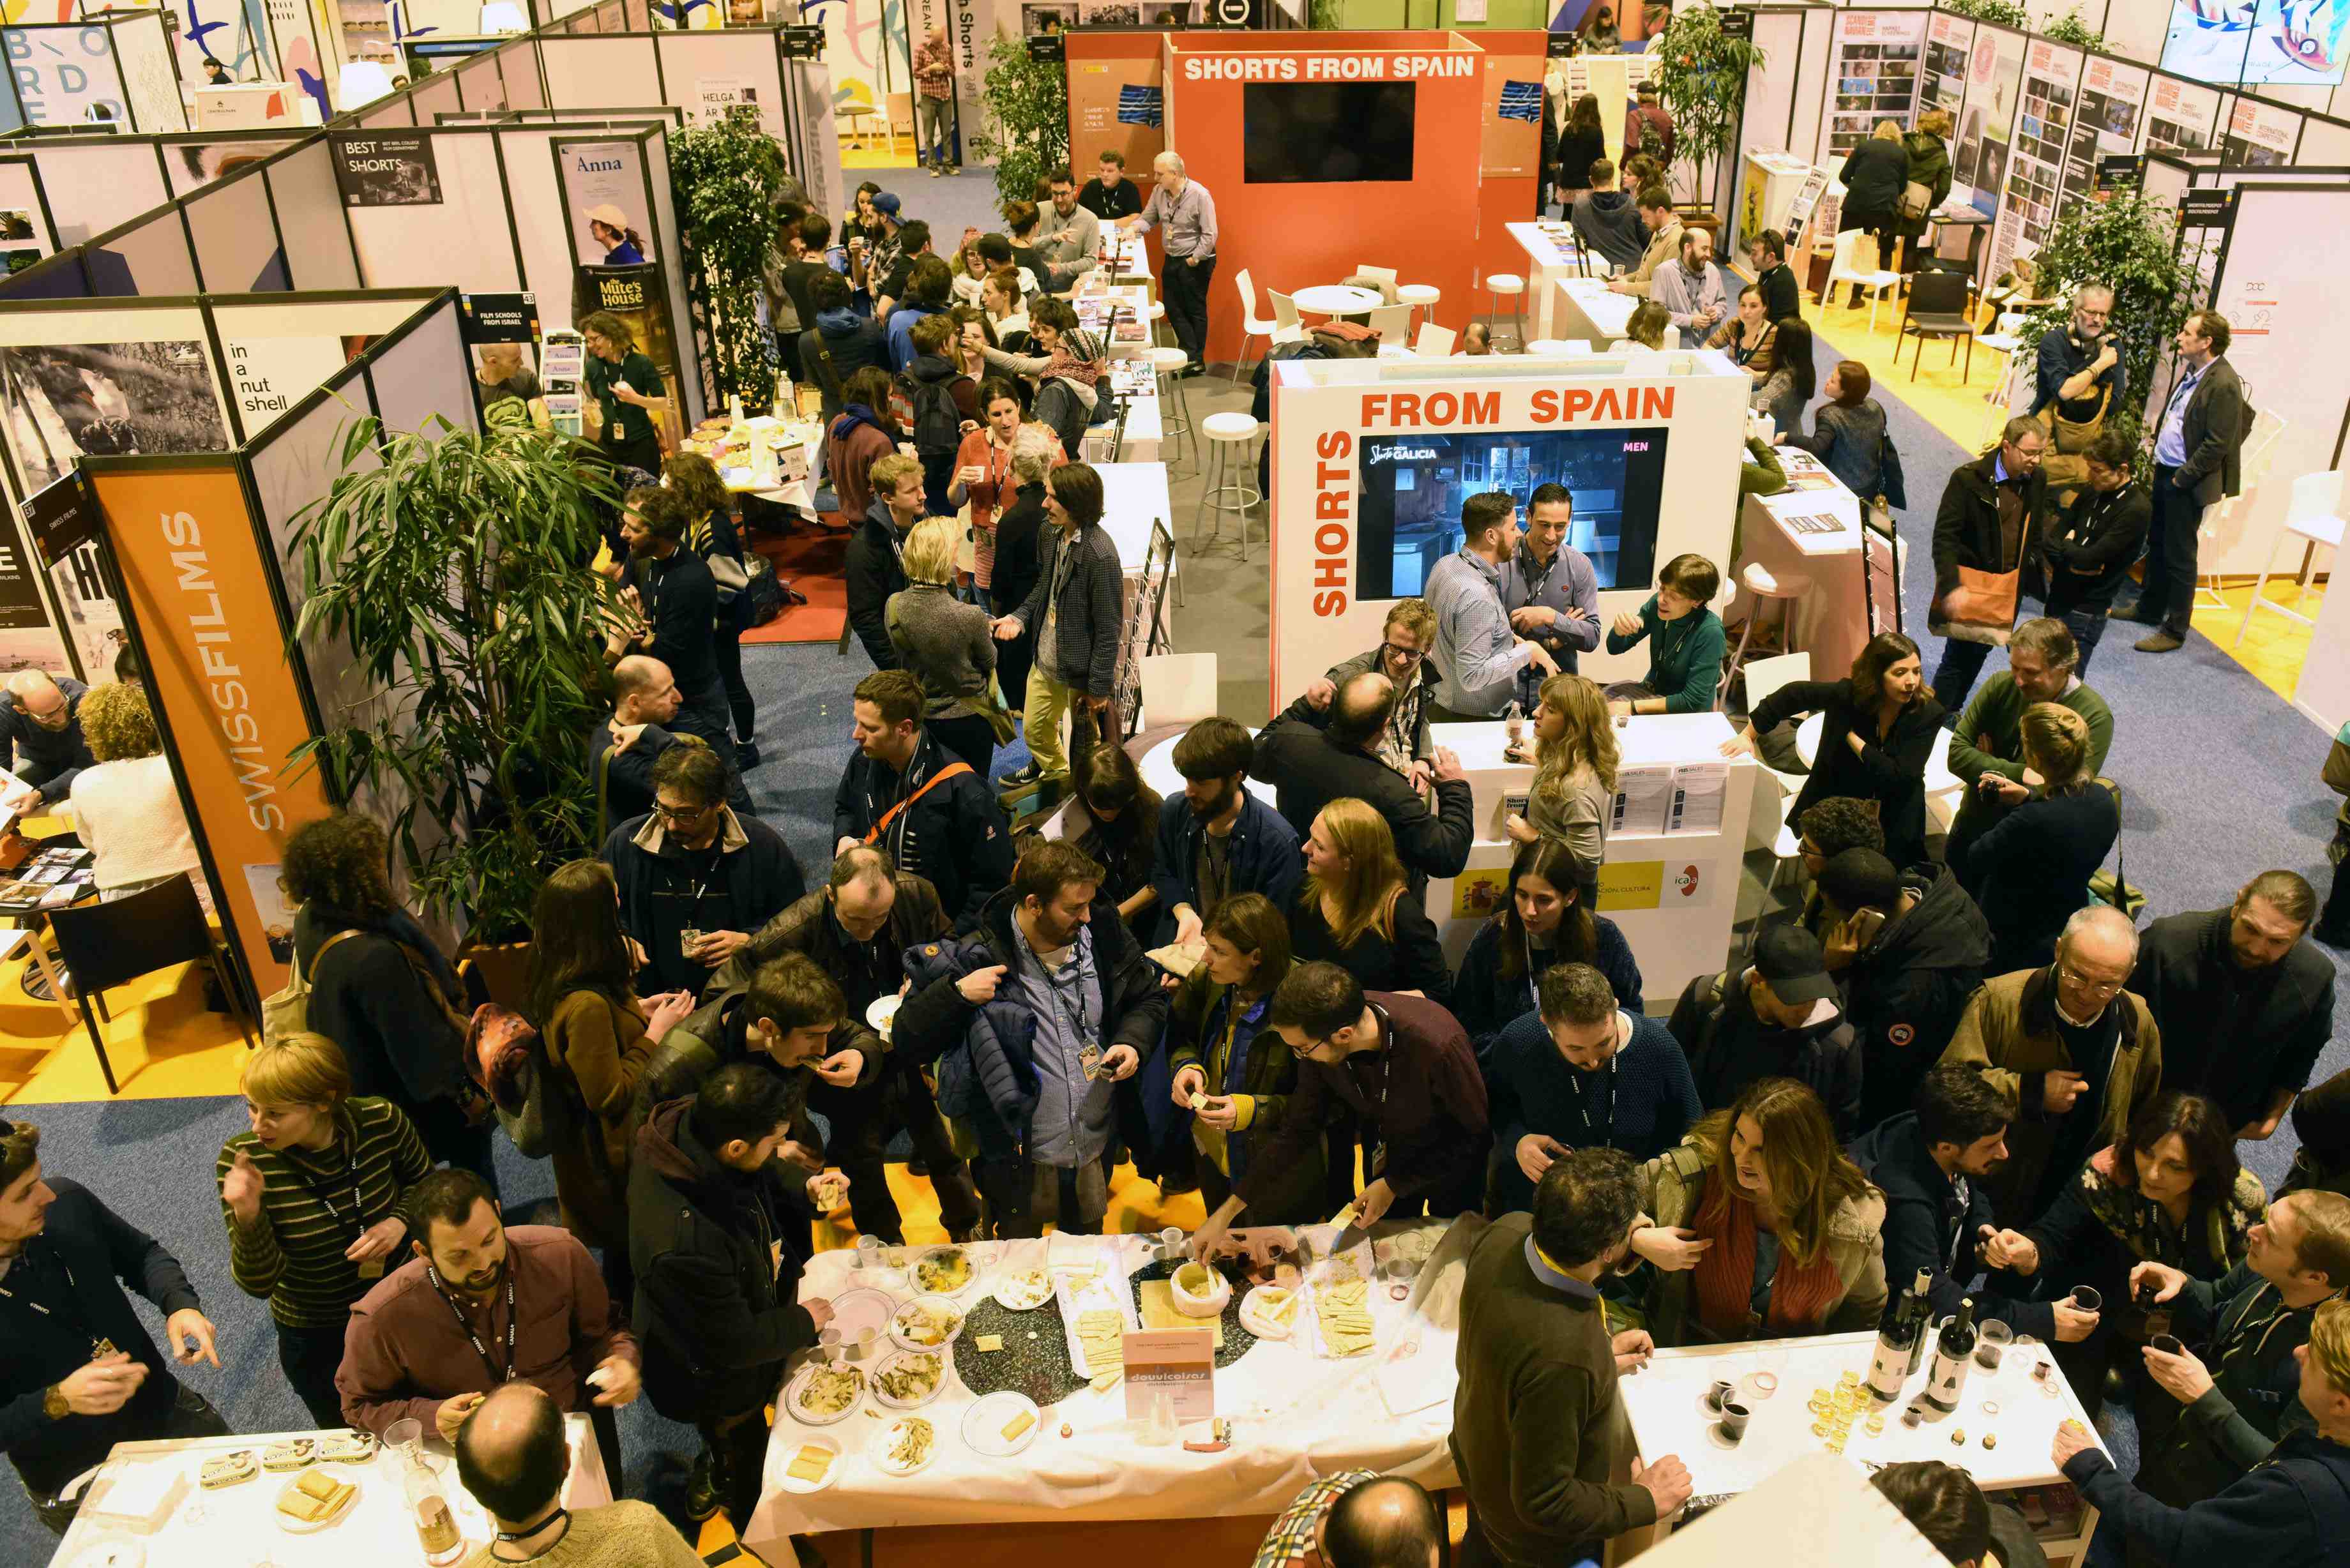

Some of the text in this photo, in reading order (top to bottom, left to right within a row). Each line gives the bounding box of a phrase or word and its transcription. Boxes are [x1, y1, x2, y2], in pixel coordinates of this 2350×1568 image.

[960, 12, 975, 68] Shorts
[1185, 56, 1474, 80] SHORTS FROM SPAIN
[702, 93, 735, 103] HELGA
[705, 105, 718, 117] ÄR
[345, 142, 377, 154] BEST
[349, 158, 404, 172] SHORTS
[577, 156, 623, 173] Anna
[599, 281, 642, 295] Mute's
[524, 295, 534, 303] 43
[602, 292, 644, 306] House
[230, 343, 248, 358] in
[236, 364, 246, 375] a
[552, 365, 570, 373] Anna
[241, 378, 271, 393] nut
[245, 395, 287, 412] shell
[1361, 386, 1676, 427] FROM SPAIN
[1623, 442, 1649, 452] MEN
[1393, 449, 1436, 460] GALICIA
[49, 507, 77, 530] SWISS FILMS
[1314, 430, 1352, 617] SHORTS
[1674, 875, 1697, 885] icaa
[696, 884, 706, 899] CANAL+
[1571, 1074, 1580, 1094] CANAL+
[1582, 1109, 1591, 1127] CANAL+
[324, 1200, 338, 1217] CANAL+
[30, 1302, 49, 1315] CANAL+
[472, 1336, 486, 1355] CANAL+
[498, 1532, 518, 1541] CANAL+
